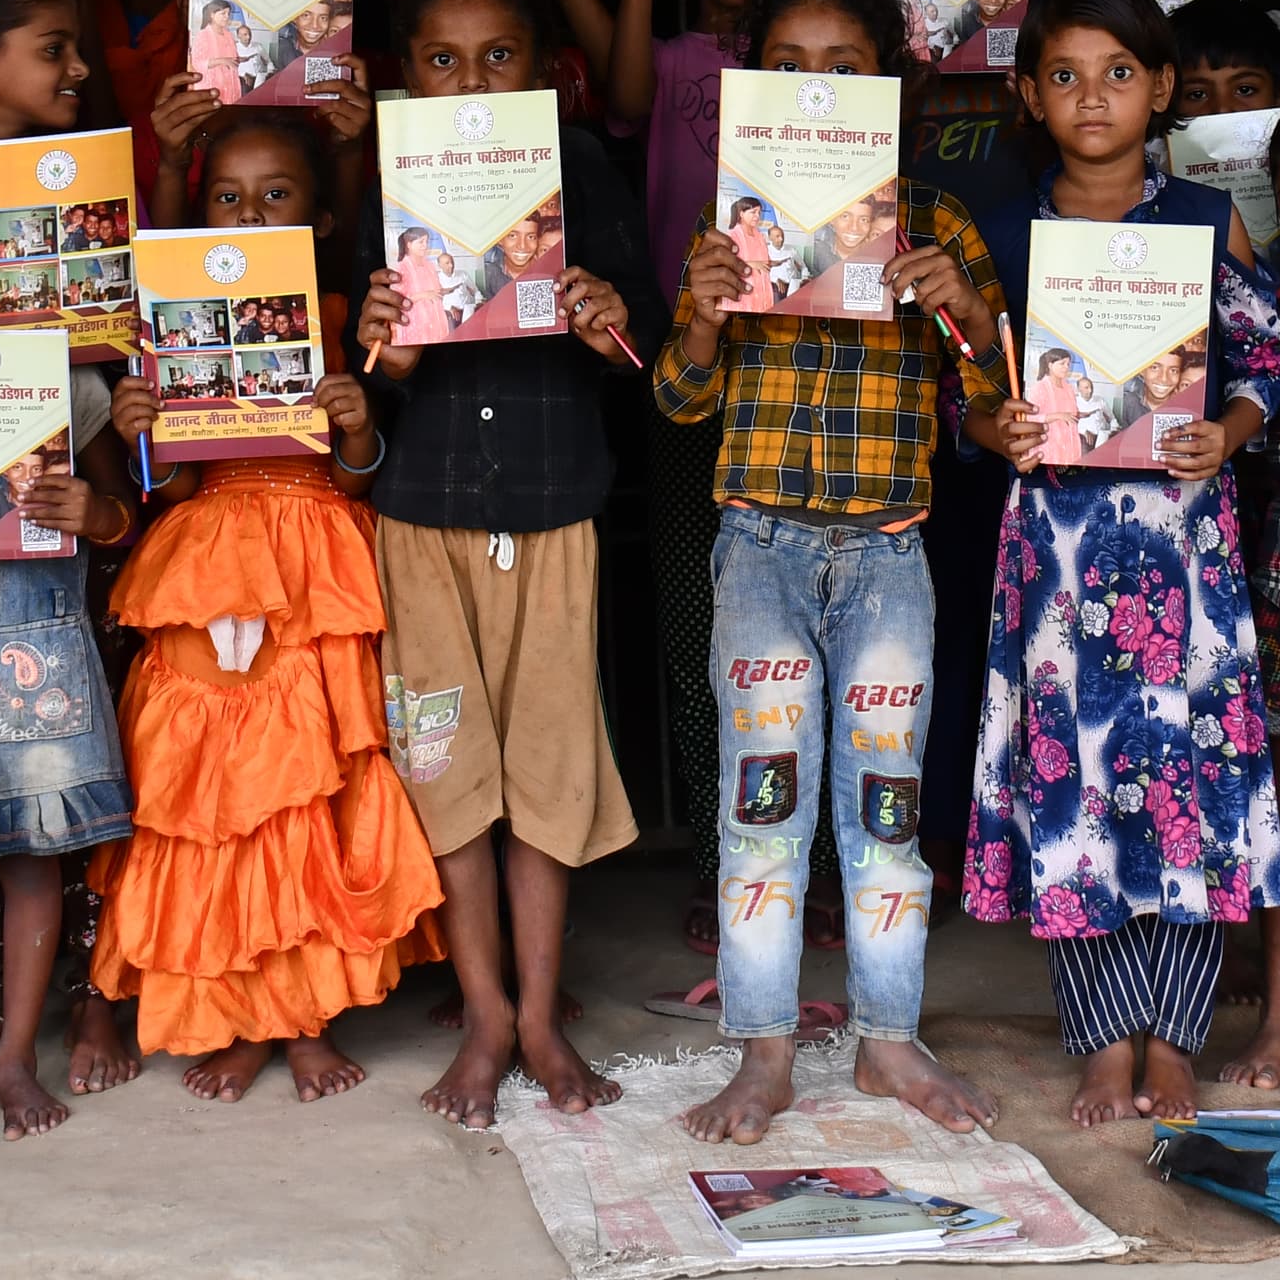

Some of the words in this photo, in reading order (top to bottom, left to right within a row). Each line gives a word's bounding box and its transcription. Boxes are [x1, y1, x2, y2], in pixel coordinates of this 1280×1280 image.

[734, 125, 774, 140] आनन्द
[776, 124, 812, 142] जीवन
[815, 126, 867, 145] फाउंडेशन
[870, 131, 893, 148] ट्रस्ट
[395, 154, 434, 169] आनन्द
[437, 149, 473, 167] जीवन
[475, 146, 527, 165] फाउंडेशन
[530, 147, 552, 164] ट्रस्ट
[786, 161, 851, 171] +91-9155751363
[1185, 162, 1220, 177] आनन्द
[450, 182, 514, 193] +91-9155751363
[1044, 276, 1084, 292] आनन्द
[1087, 275, 1123, 293] जीवन
[1126, 277, 1178, 296] फाउंडेशन
[1181, 282, 1204, 299] ट्रस्ट
[1096, 312, 1162, 322] +91-9155751363
[37, 388, 60, 404] ट्रस्ट
[164, 415, 201, 428] आनन्द
[205, 411, 237, 426] जीवन
[241, 408, 289, 424] फाउंडेशन
[291, 409, 313, 424] ट्रस्ट
[734, 703, 804, 732] END
[728, 836, 803, 860] JUST
